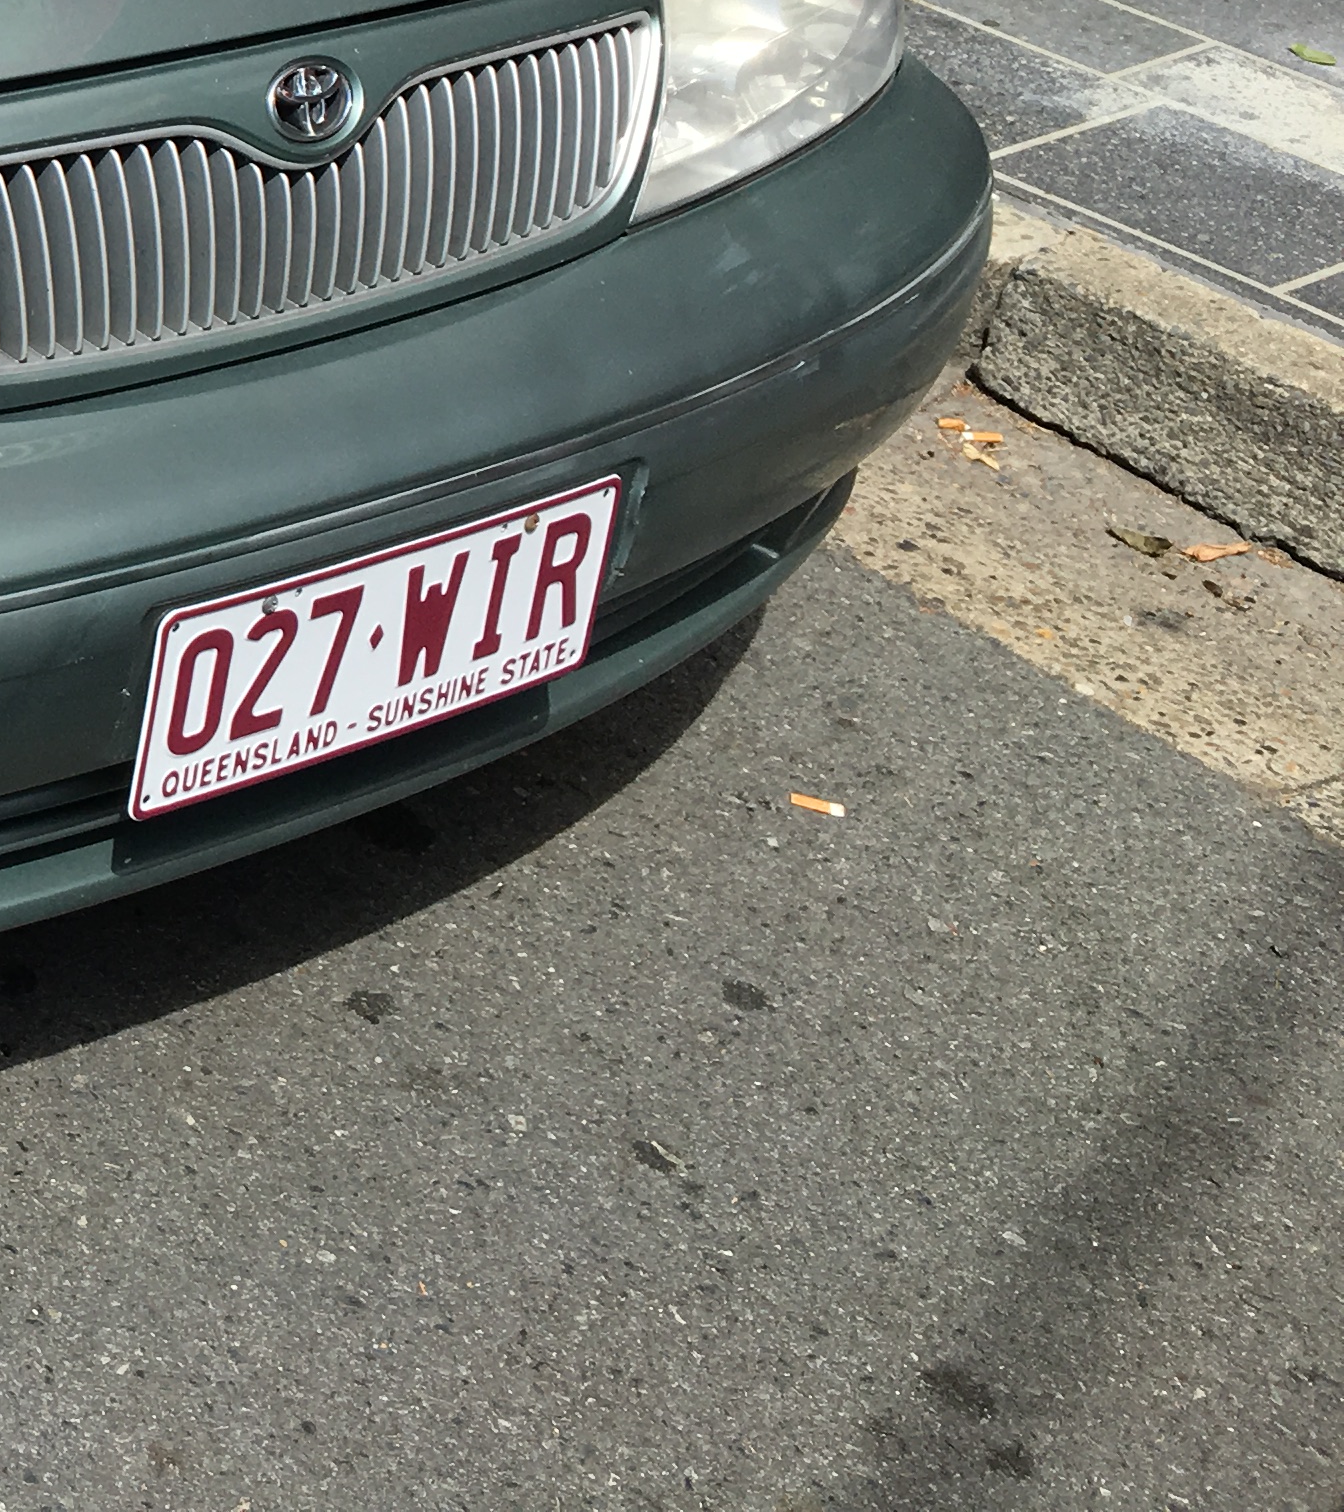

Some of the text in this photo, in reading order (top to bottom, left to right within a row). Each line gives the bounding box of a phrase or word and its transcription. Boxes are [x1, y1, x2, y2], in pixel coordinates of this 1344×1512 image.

[161, 719, 339, 798] QUEENSLAND
[366, 665, 489, 734] SUNSHINE
[500, 640, 571, 686] STATE
